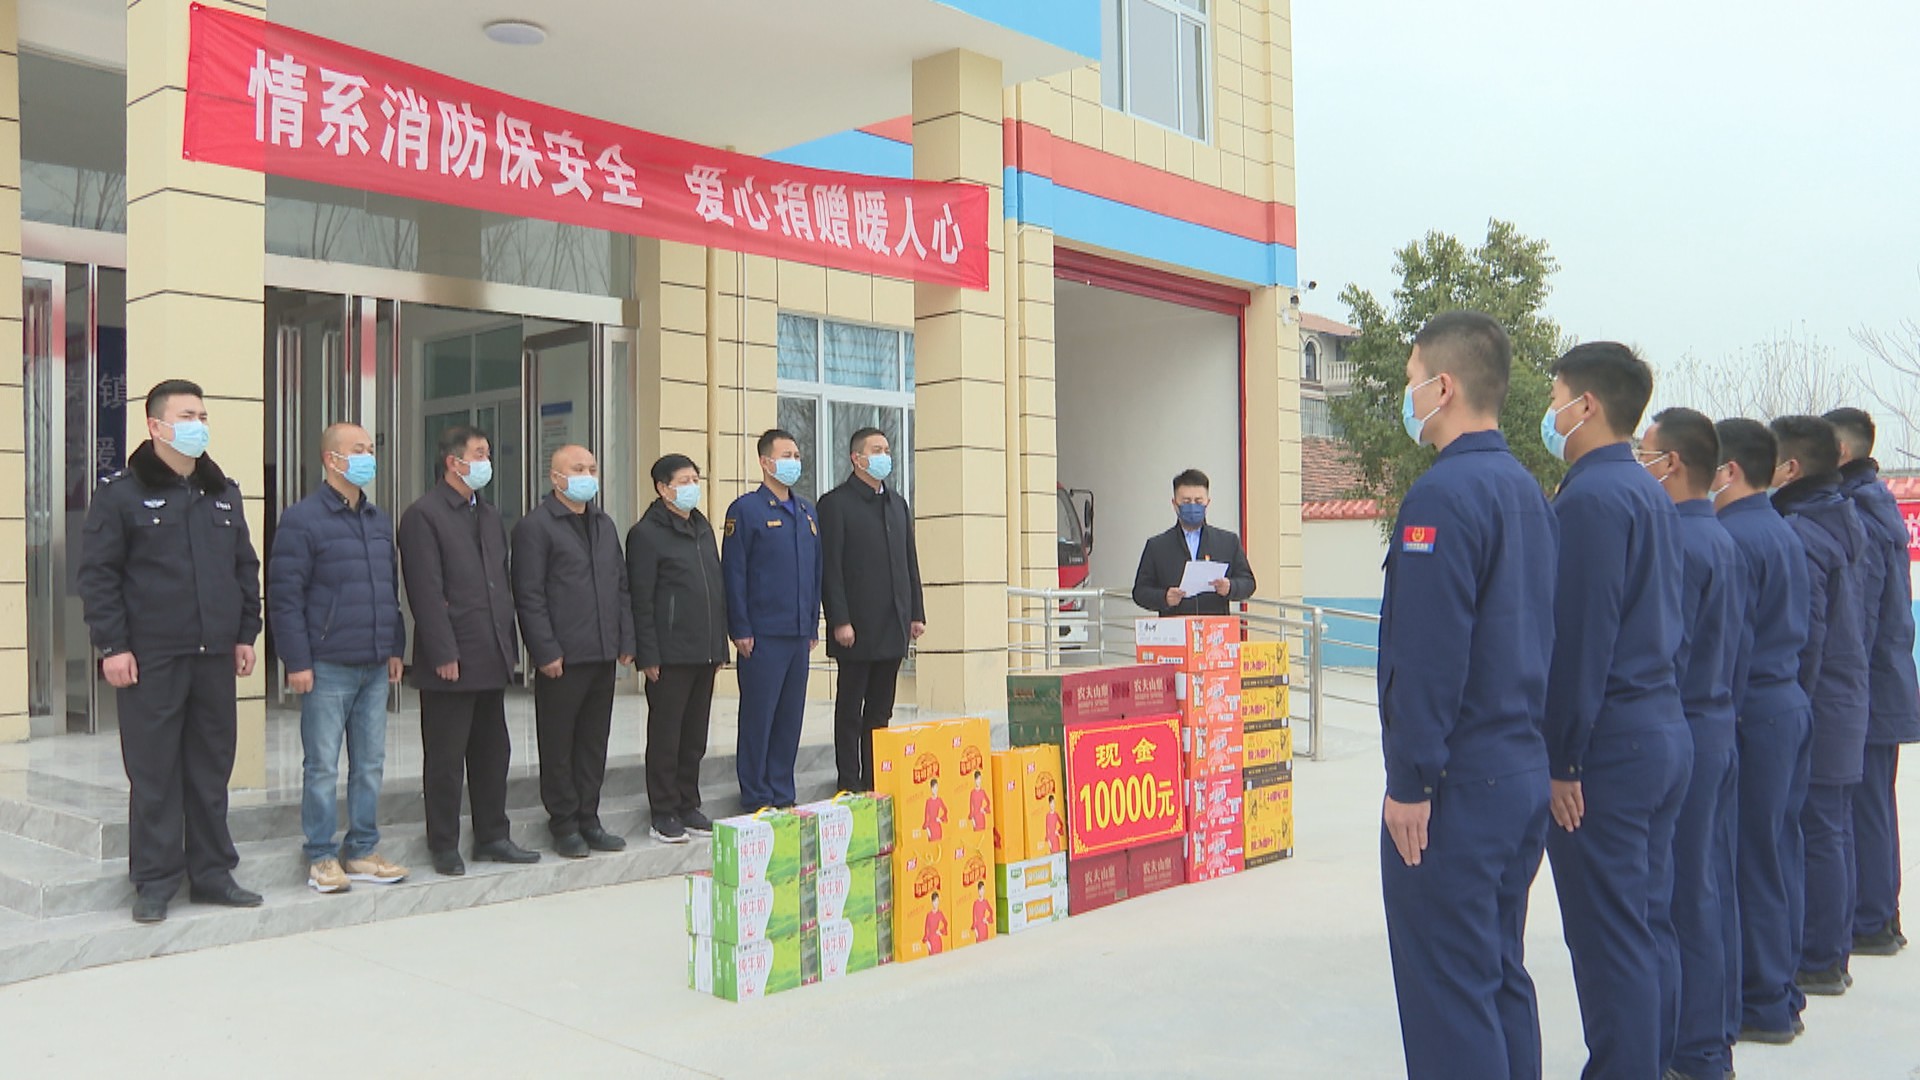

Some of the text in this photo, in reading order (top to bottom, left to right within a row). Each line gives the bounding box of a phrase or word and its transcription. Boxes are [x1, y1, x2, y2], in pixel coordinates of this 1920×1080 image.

[247, 48, 963, 264] 情系消防保安全 爱心捐赠暖人心
[1095, 737, 1157, 769] 现金
[1080, 773, 1175, 832] 10000元
